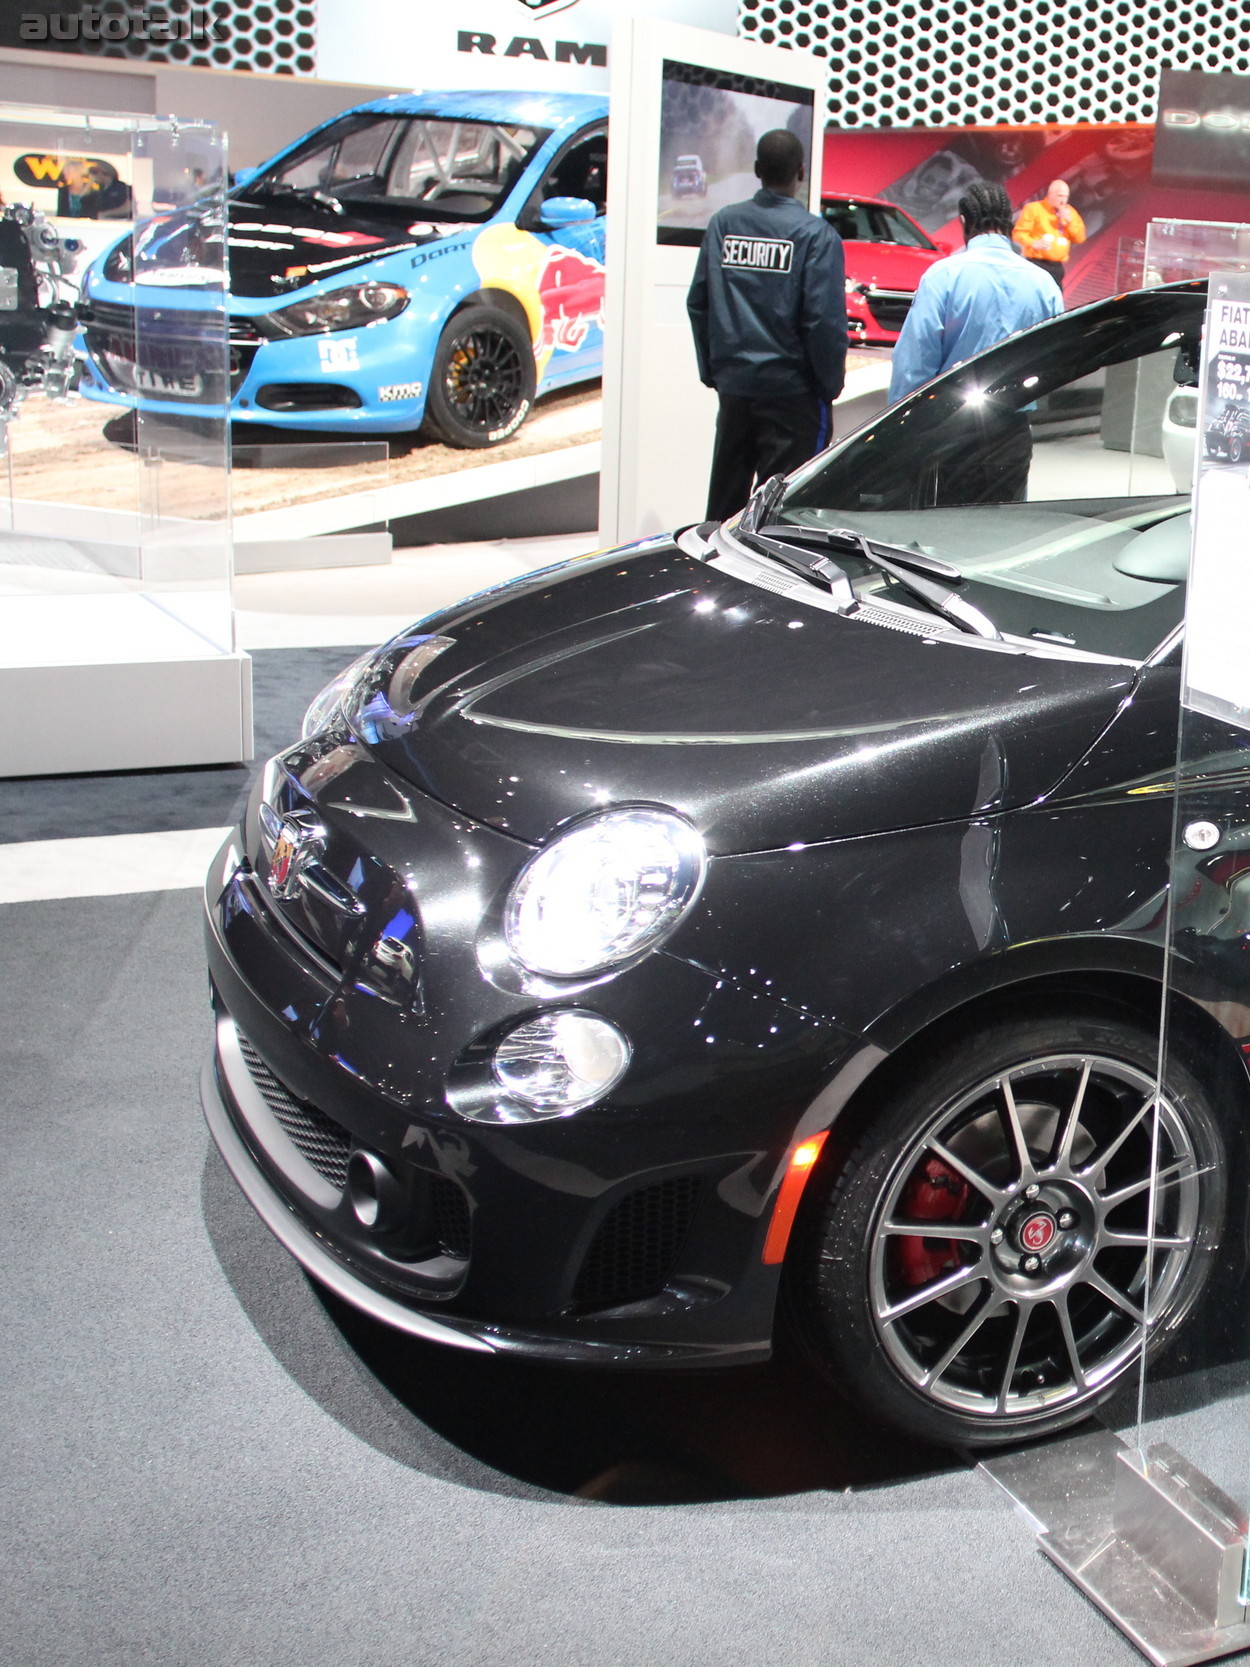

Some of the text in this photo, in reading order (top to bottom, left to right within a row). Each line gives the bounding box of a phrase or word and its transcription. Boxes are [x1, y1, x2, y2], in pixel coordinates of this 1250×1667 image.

[457, 30, 608, 68] RAM
[722, 239, 791, 269] SECURITY
[1221, 305, 1250, 325] FIAT
